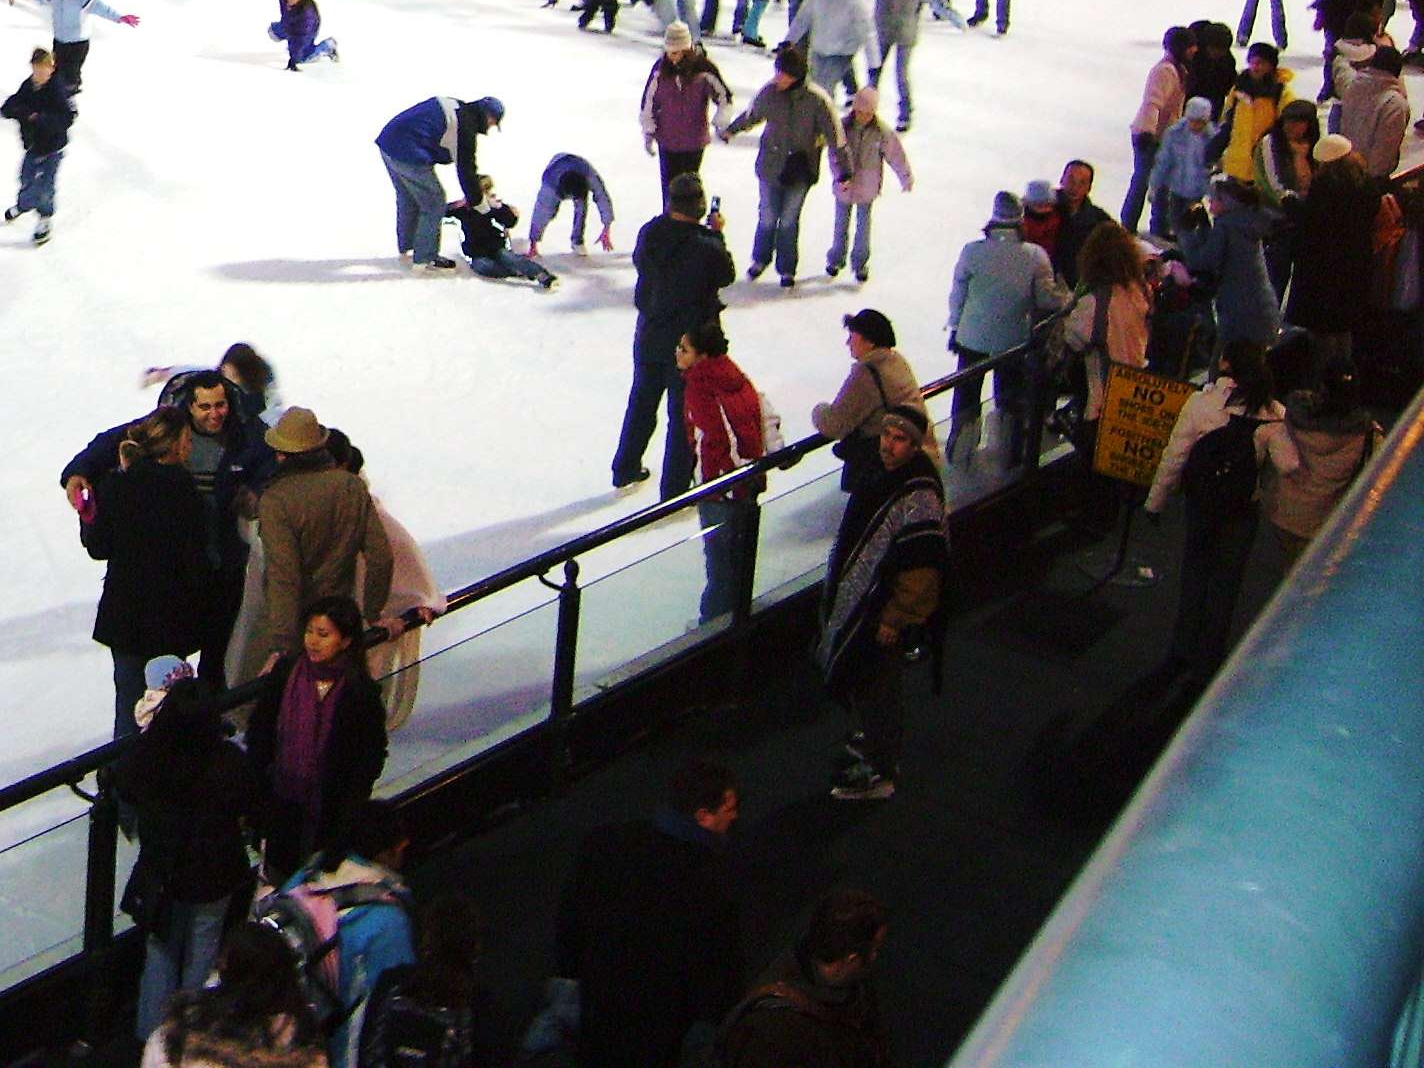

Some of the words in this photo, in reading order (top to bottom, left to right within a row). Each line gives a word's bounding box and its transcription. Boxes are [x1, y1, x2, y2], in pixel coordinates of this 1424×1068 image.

[1115, 368, 1189, 395] ABSOLUTELY
[1133, 385, 1166, 405] NO
[1124, 439, 1155, 460] NO
